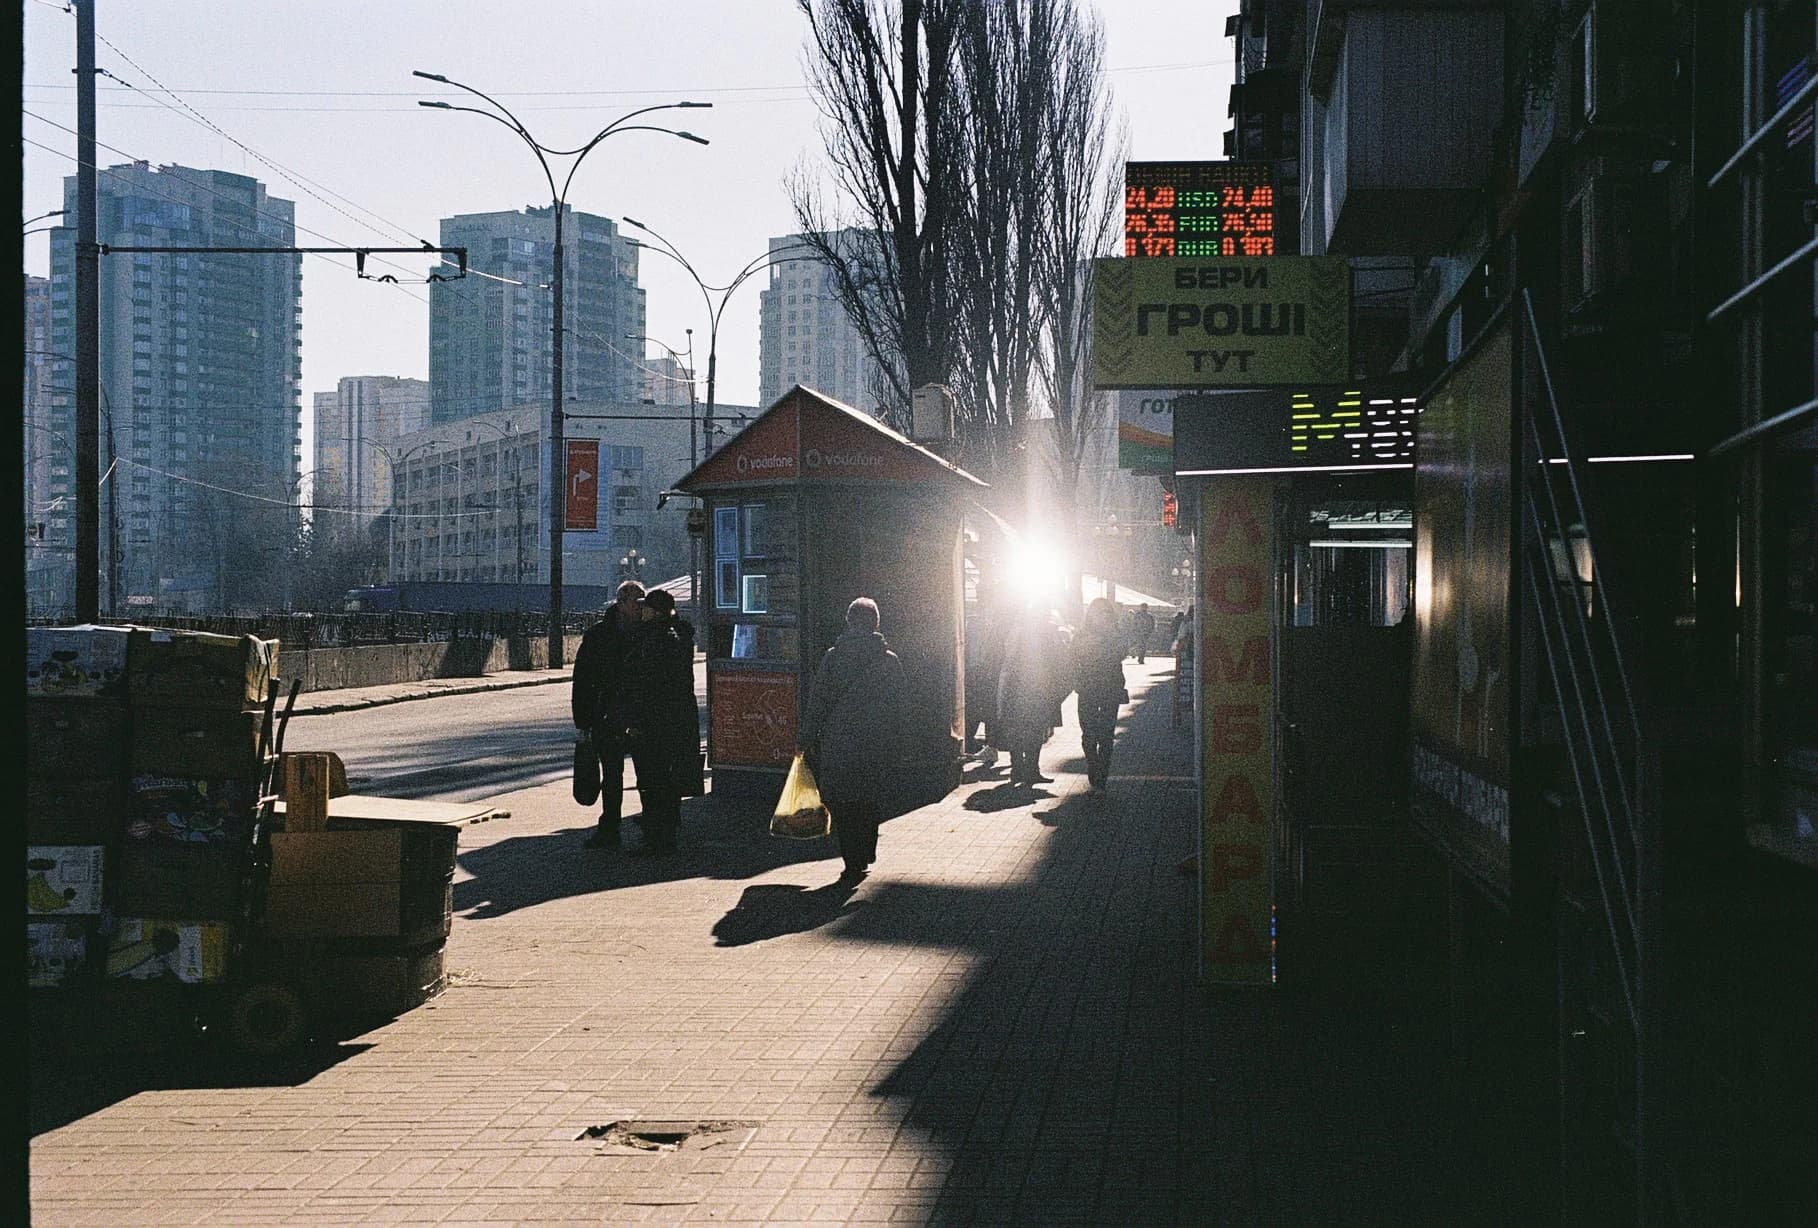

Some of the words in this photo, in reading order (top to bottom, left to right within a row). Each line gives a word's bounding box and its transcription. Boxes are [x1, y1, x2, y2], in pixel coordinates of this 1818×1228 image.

[1178, 192, 1218, 207] USD
[1175, 267, 1268, 289] БЕРИ
[1137, 303, 1305, 336] ГРОШІ
[1186, 350, 1254, 372] ТУТ
[750, 454, 793, 469] vodafone
[825, 453, 884, 467] vodafone
[1202, 495, 1272, 965] ЛОМБАРД
